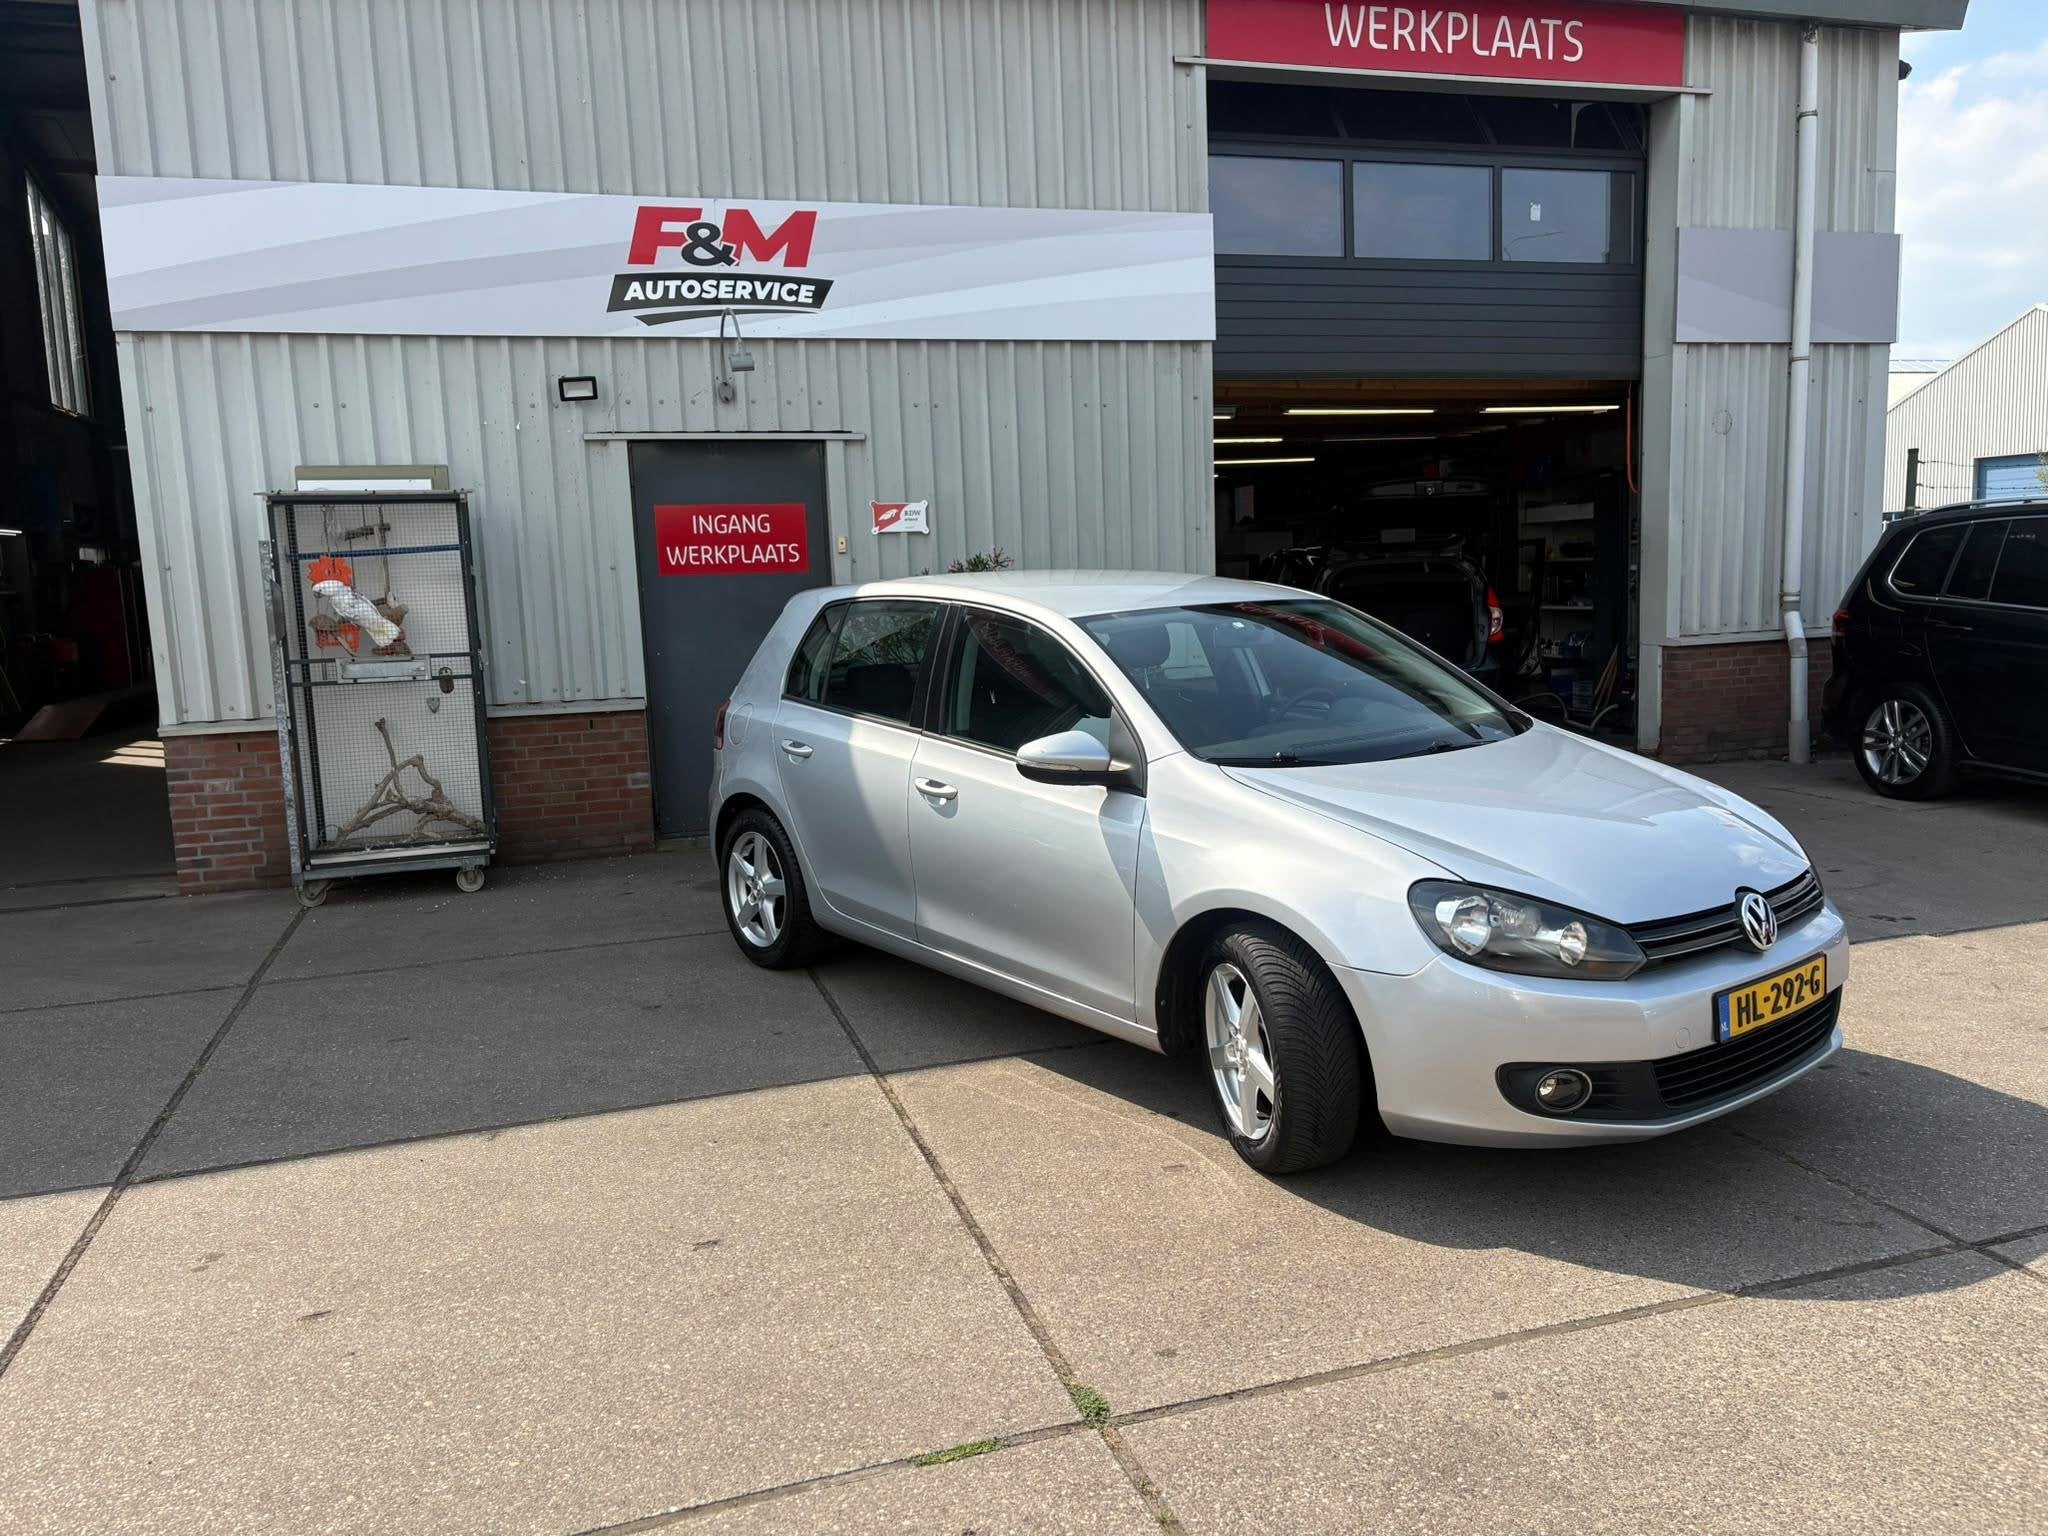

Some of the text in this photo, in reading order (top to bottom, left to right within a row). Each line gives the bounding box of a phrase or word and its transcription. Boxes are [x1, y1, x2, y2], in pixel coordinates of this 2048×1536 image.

[1325, 3, 1583, 62] WERKPLAATS
[628, 206, 817, 267] F&M
[624, 280, 816, 303] AUTOSERVICE
[692, 514, 770, 534] INGANG
[666, 543, 800, 565] WERKPLAATS
[1736, 965, 1820, 1028] HL-292-G
